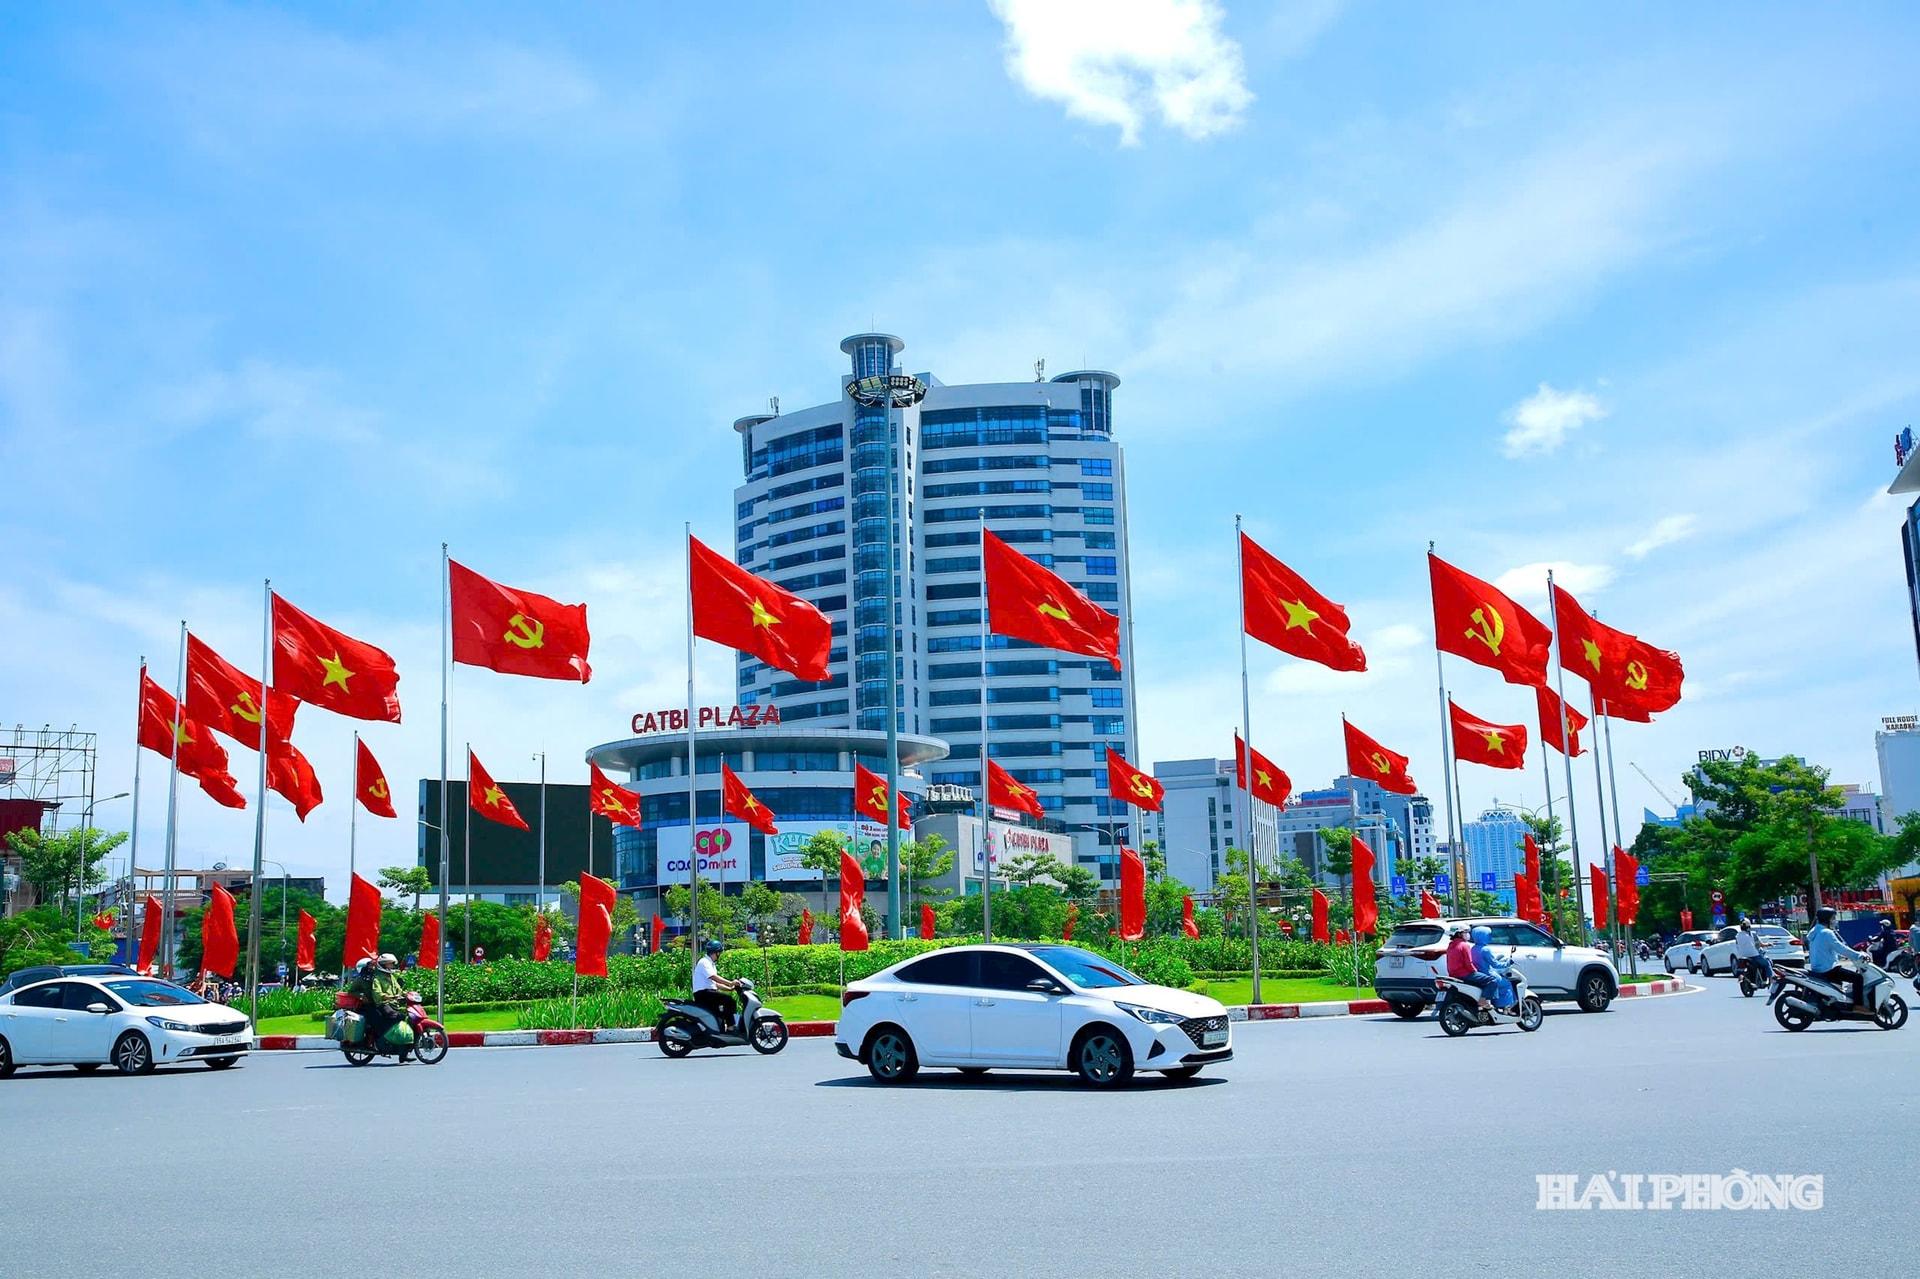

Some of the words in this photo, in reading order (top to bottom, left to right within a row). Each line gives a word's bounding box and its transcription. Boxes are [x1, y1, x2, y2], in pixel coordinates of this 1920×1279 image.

[632, 708, 689, 734] CATBI
[698, 704, 781, 728] PLAZA
[1698, 748, 1732, 762] BIDV
